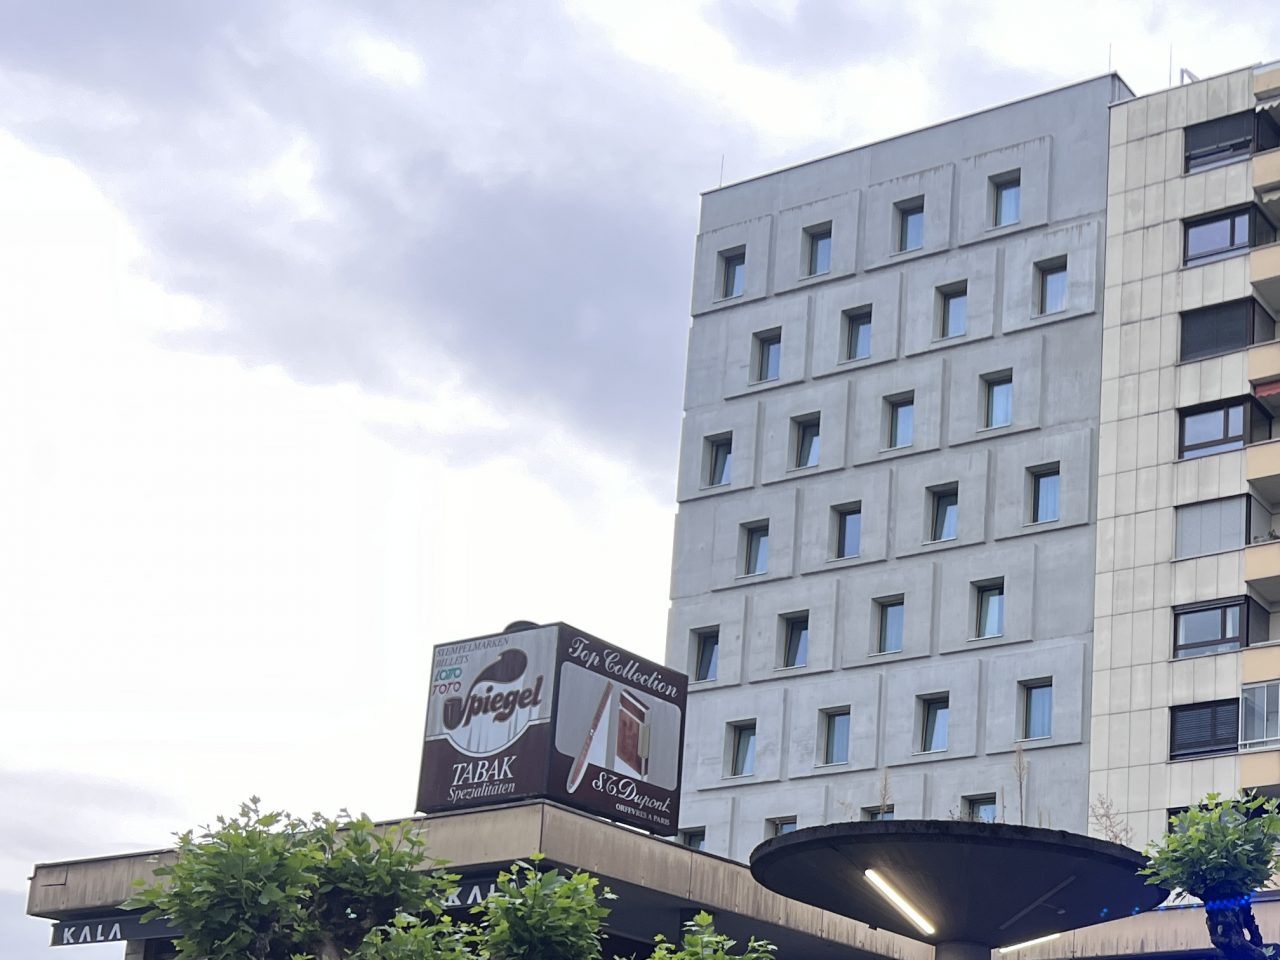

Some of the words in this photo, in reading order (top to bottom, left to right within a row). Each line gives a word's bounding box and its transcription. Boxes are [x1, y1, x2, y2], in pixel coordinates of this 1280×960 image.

[437, 636, 510, 657] STEMPELMARKEN
[436, 655, 469, 668] BILLETS
[568, 636, 600, 668] Top
[603, 650, 678, 698] Collection
[432, 681, 462, 696] TOTO
[452, 755, 518, 786] TABAK
[447, 782, 516, 804] Spezialitäten
[653, 815, 670, 826] PARIS
[63, 923, 122, 944] KALA
